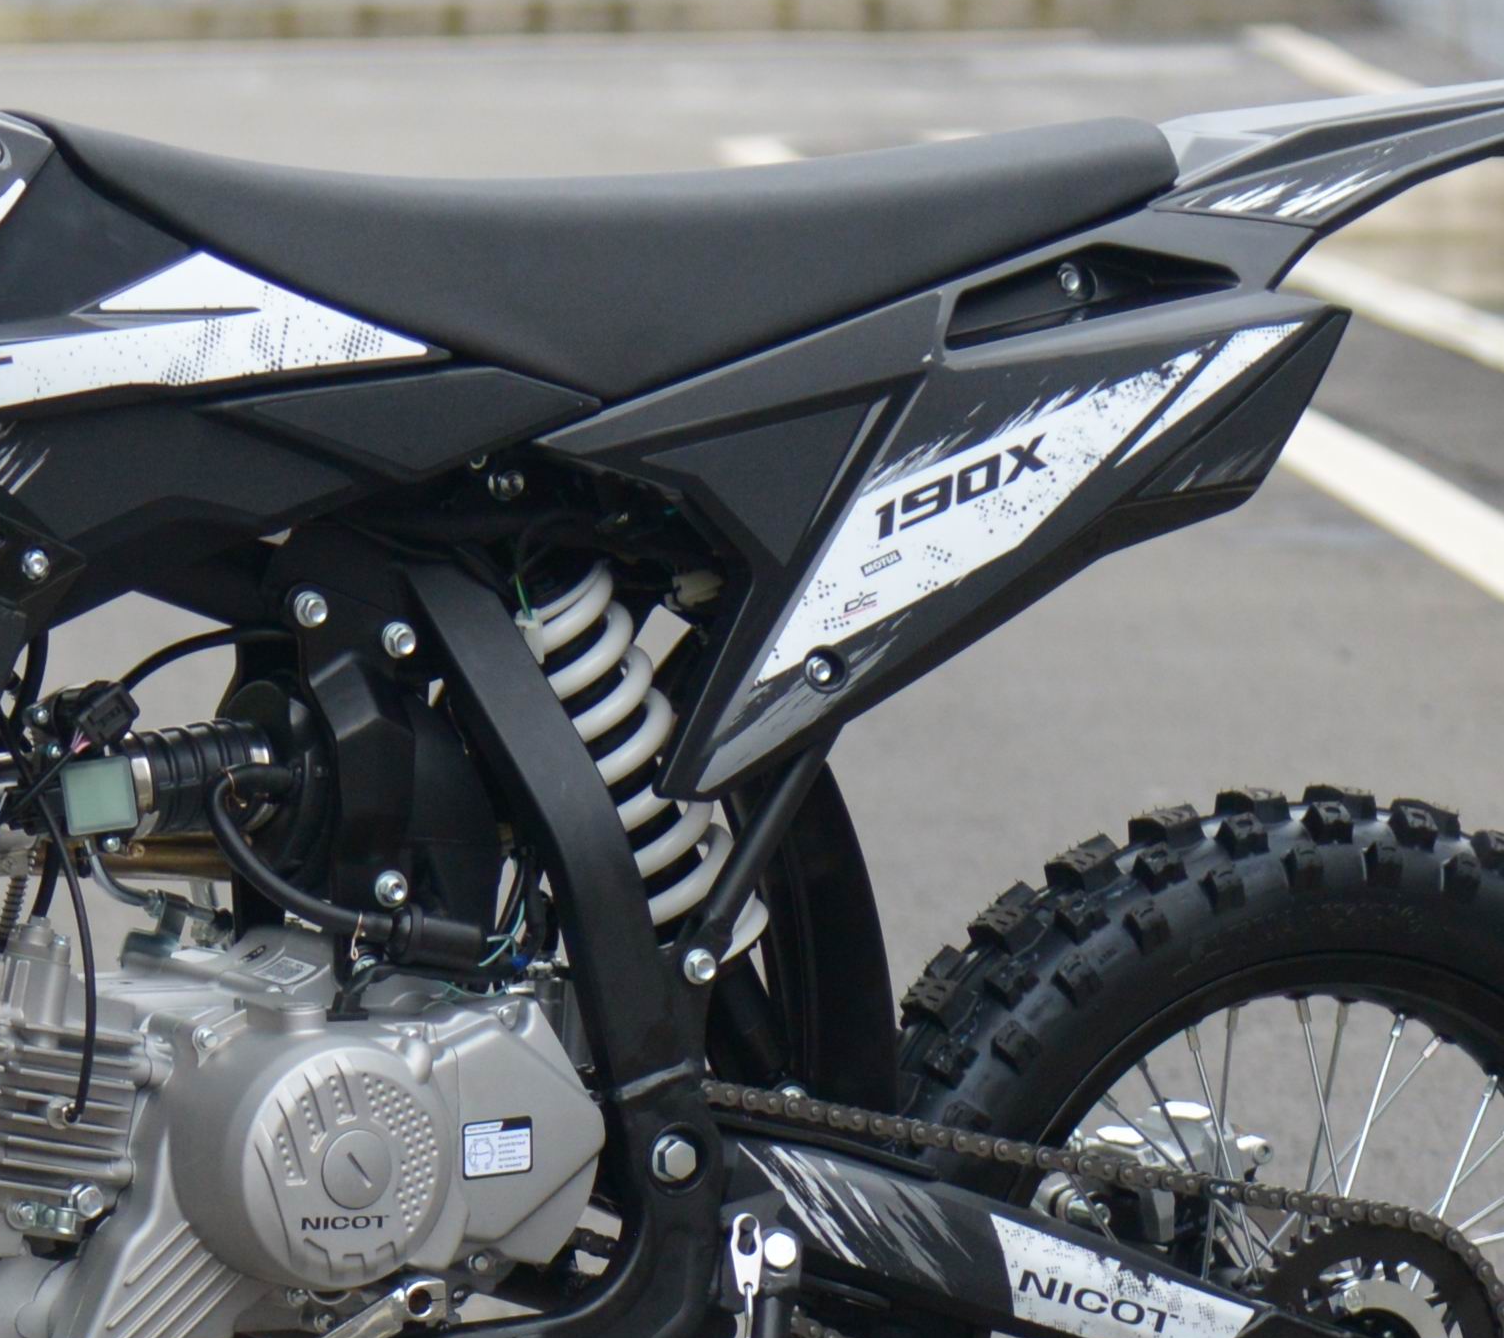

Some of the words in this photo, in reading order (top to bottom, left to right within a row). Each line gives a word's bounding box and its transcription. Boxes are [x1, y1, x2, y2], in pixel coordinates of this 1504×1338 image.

[874, 433, 1049, 541] 190X
[862, 550, 902, 577] MOTUL
[301, 1215, 390, 1231] NICOT
[1017, 1268, 1182, 1336] NICOT
